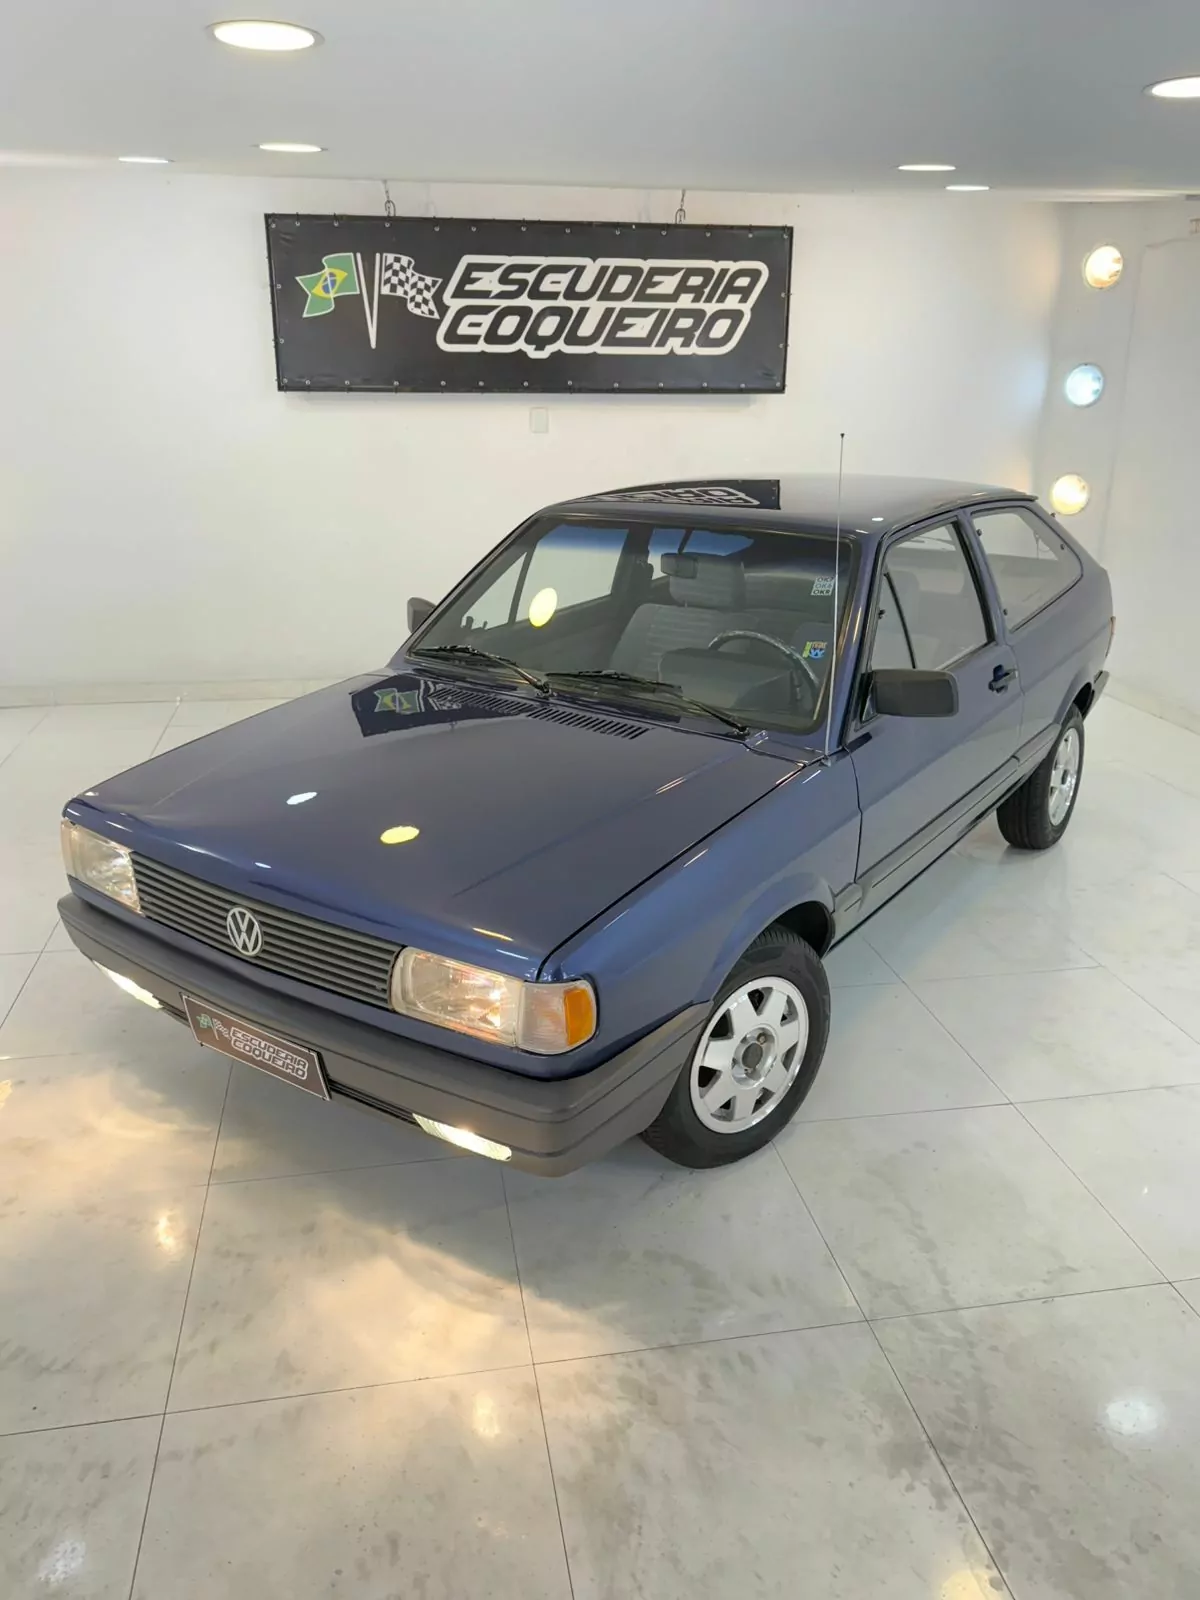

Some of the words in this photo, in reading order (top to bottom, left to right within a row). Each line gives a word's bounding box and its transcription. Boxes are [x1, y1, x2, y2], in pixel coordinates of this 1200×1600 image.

[450, 262, 763, 304] ESCUDERIA
[442, 304, 745, 351] COQUEIRO
[227, 908, 261, 955] VW
[232, 1029, 307, 1069] ESCUDERIA
[233, 1040, 306, 1078] COQUEIRO
